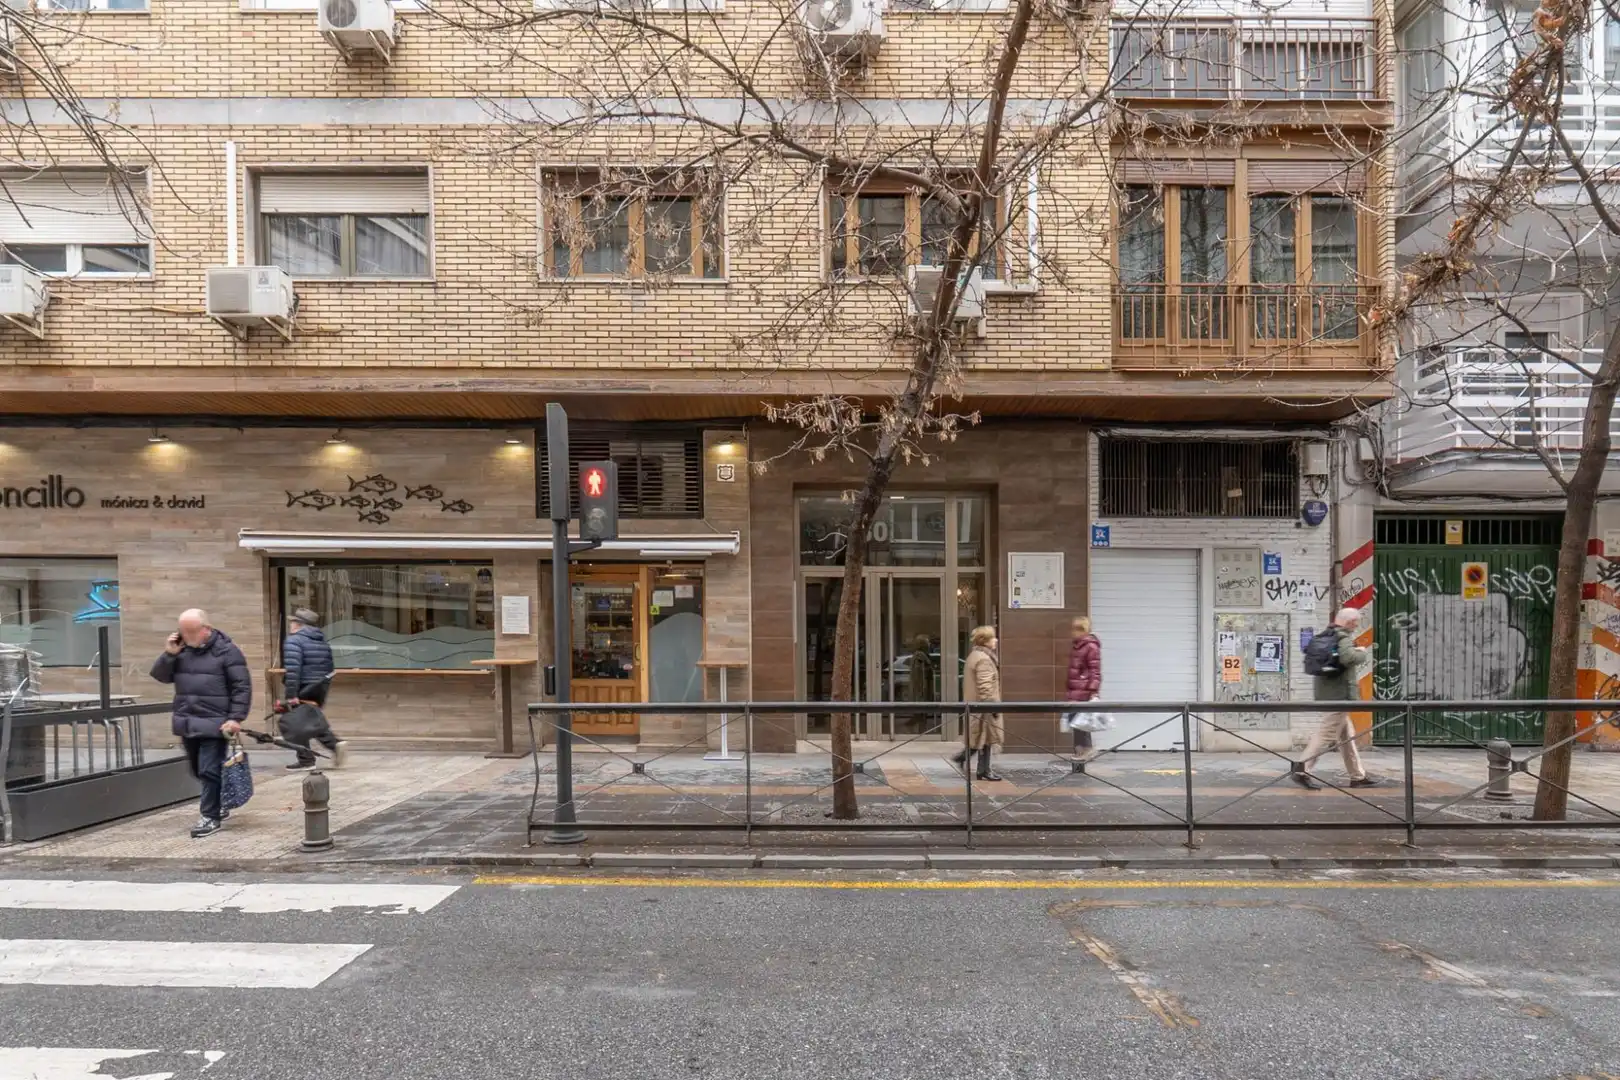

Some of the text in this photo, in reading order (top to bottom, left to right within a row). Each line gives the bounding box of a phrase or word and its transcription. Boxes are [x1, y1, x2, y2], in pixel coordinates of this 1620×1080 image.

[0, 474, 205, 509] ncillo mónica & david
[1224, 658, 1240, 669] B2
